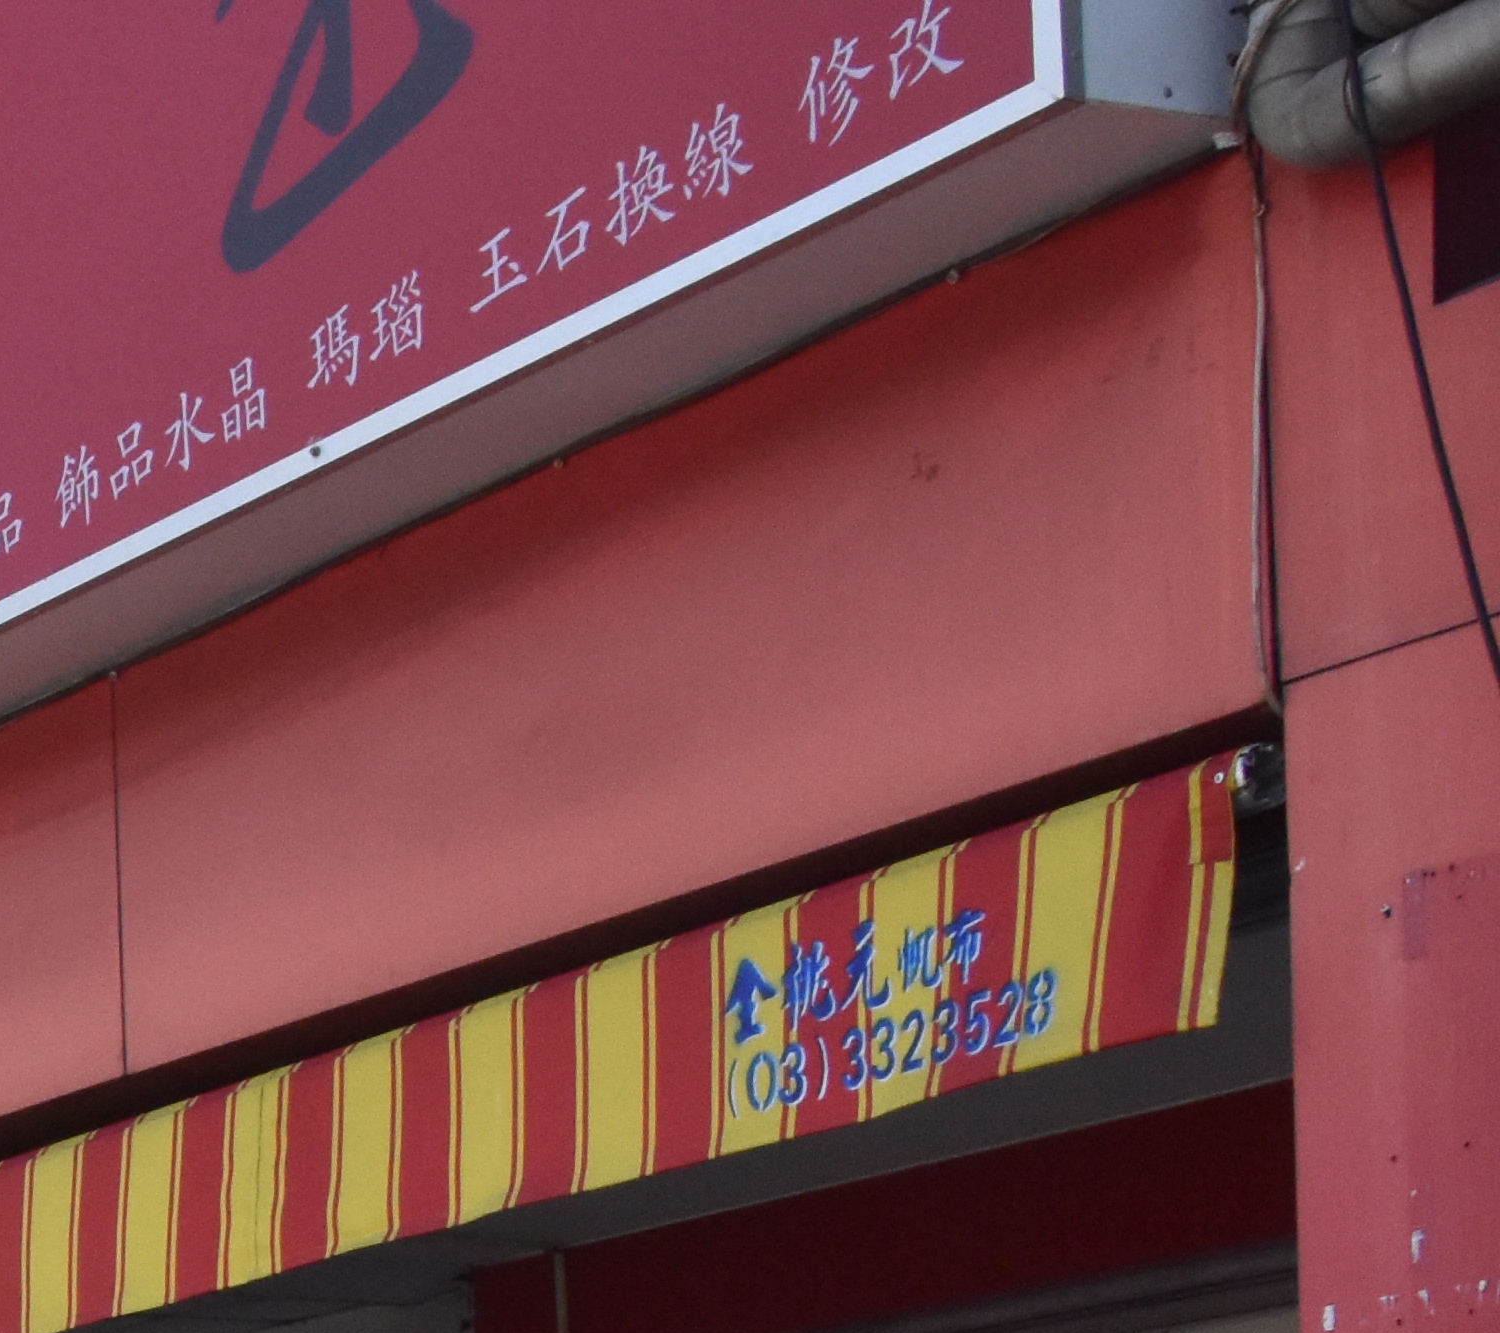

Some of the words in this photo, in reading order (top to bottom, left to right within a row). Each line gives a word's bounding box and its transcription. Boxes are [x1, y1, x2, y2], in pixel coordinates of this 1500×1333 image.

[54, 355, 269, 529] 飾品水晶
[307, 269, 423, 390] 瑪瑙
[469, 101, 754, 315] 玉石換線
[797, 0, 965, 149] 修改
[728, 967, 1059, 1120] (03)3323528
